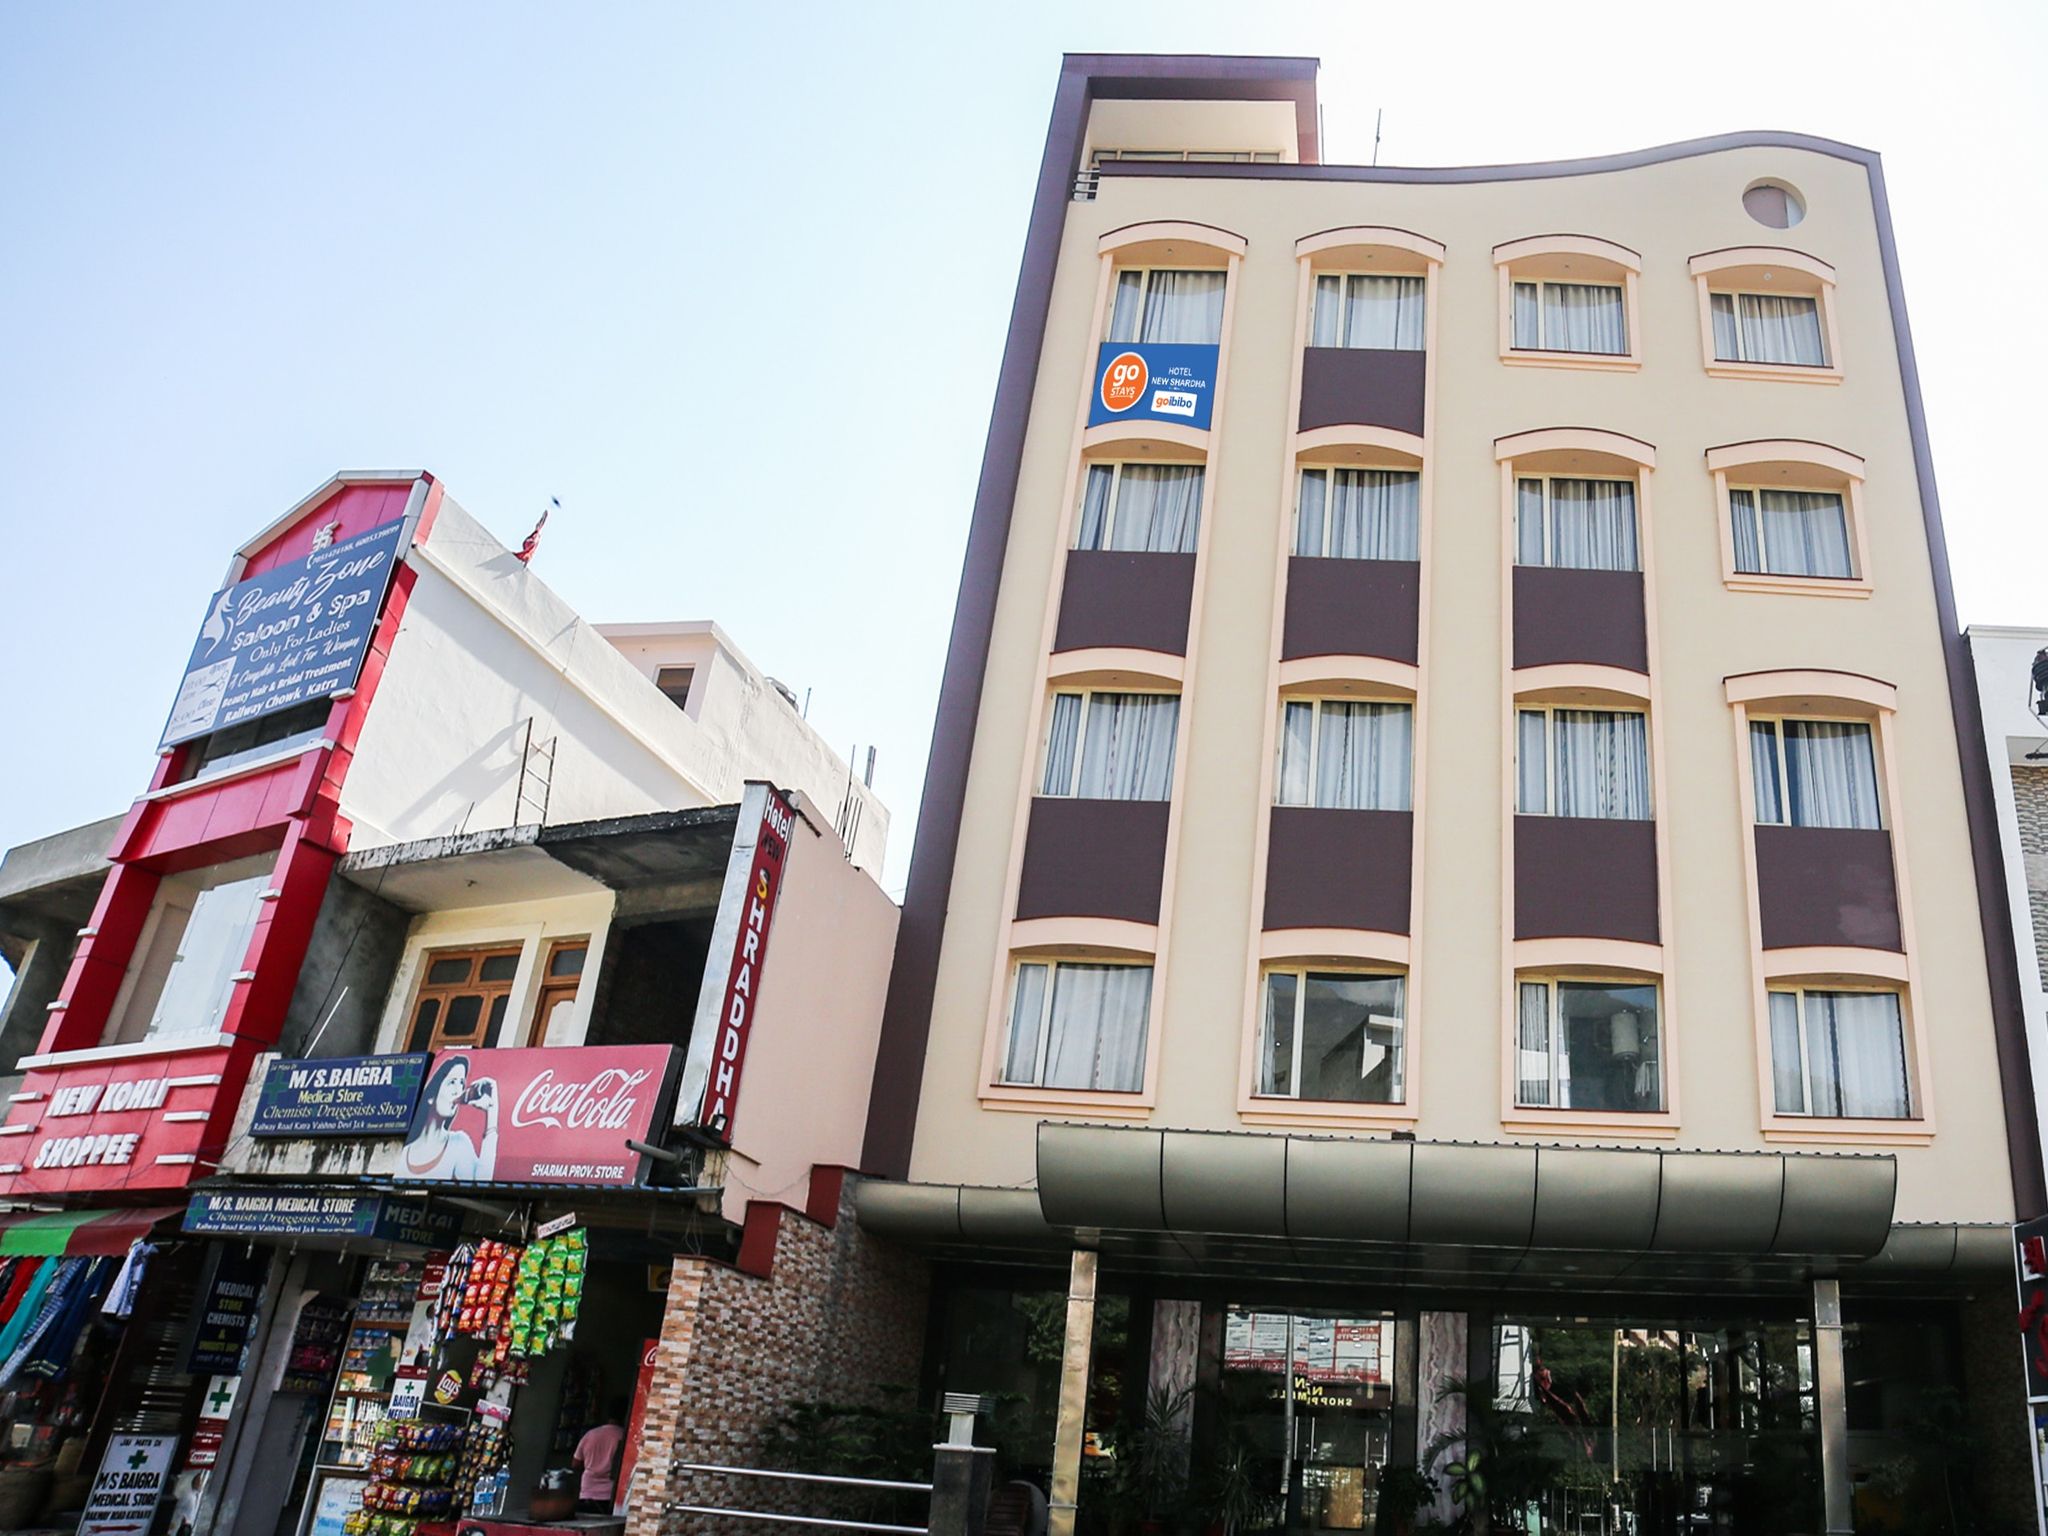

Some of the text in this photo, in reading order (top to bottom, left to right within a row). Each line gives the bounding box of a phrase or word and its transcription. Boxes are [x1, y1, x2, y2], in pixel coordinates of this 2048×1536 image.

[1113, 364, 1139, 387] go
[1168, 367, 1192, 377] HOTEL
[1151, 377, 1169, 386] NEW
[1110, 386, 1136, 396] STAYS
[1156, 395, 1193, 408] goibibo
[237, 550, 387, 626] Beauty Zone
[231, 589, 371, 652] Saloon & Spa
[250, 619, 351, 663] Only For Ladies
[303, 657, 353, 681] Treatment
[223, 677, 339, 724] Railway Chowk Katra
[763, 793, 793, 843] Hotel
[46, 1077, 170, 1118] NEW KOHLI
[297, 1088, 364, 1105] Medical Store
[511, 1068, 652, 1130] Coca-Cola
[262, 1104, 312, 1119] Chemists
[377, 1100, 408, 1119] Shop
[33, 1133, 141, 1169] SHOPPEE
[531, 1163, 568, 1177] SHARMA
[594, 1165, 625, 1178] STORE
[235, 1197, 275, 1212] BAIGRA
[275, 1197, 320, 1213] MEDICAL
[322, 1198, 356, 1213] STORE
[208, 1212, 257, 1222] Chemists
[322, 1212, 353, 1226] Shop
[399, 1227, 434, 1244] STORE
[216, 1280, 255, 1298] MEDICAL
[206, 1311, 246, 1327] CHEMISTS
[119, 1472, 160, 1489] BAIGRA
[91, 1493, 158, 1507] MEDICAL STORE
